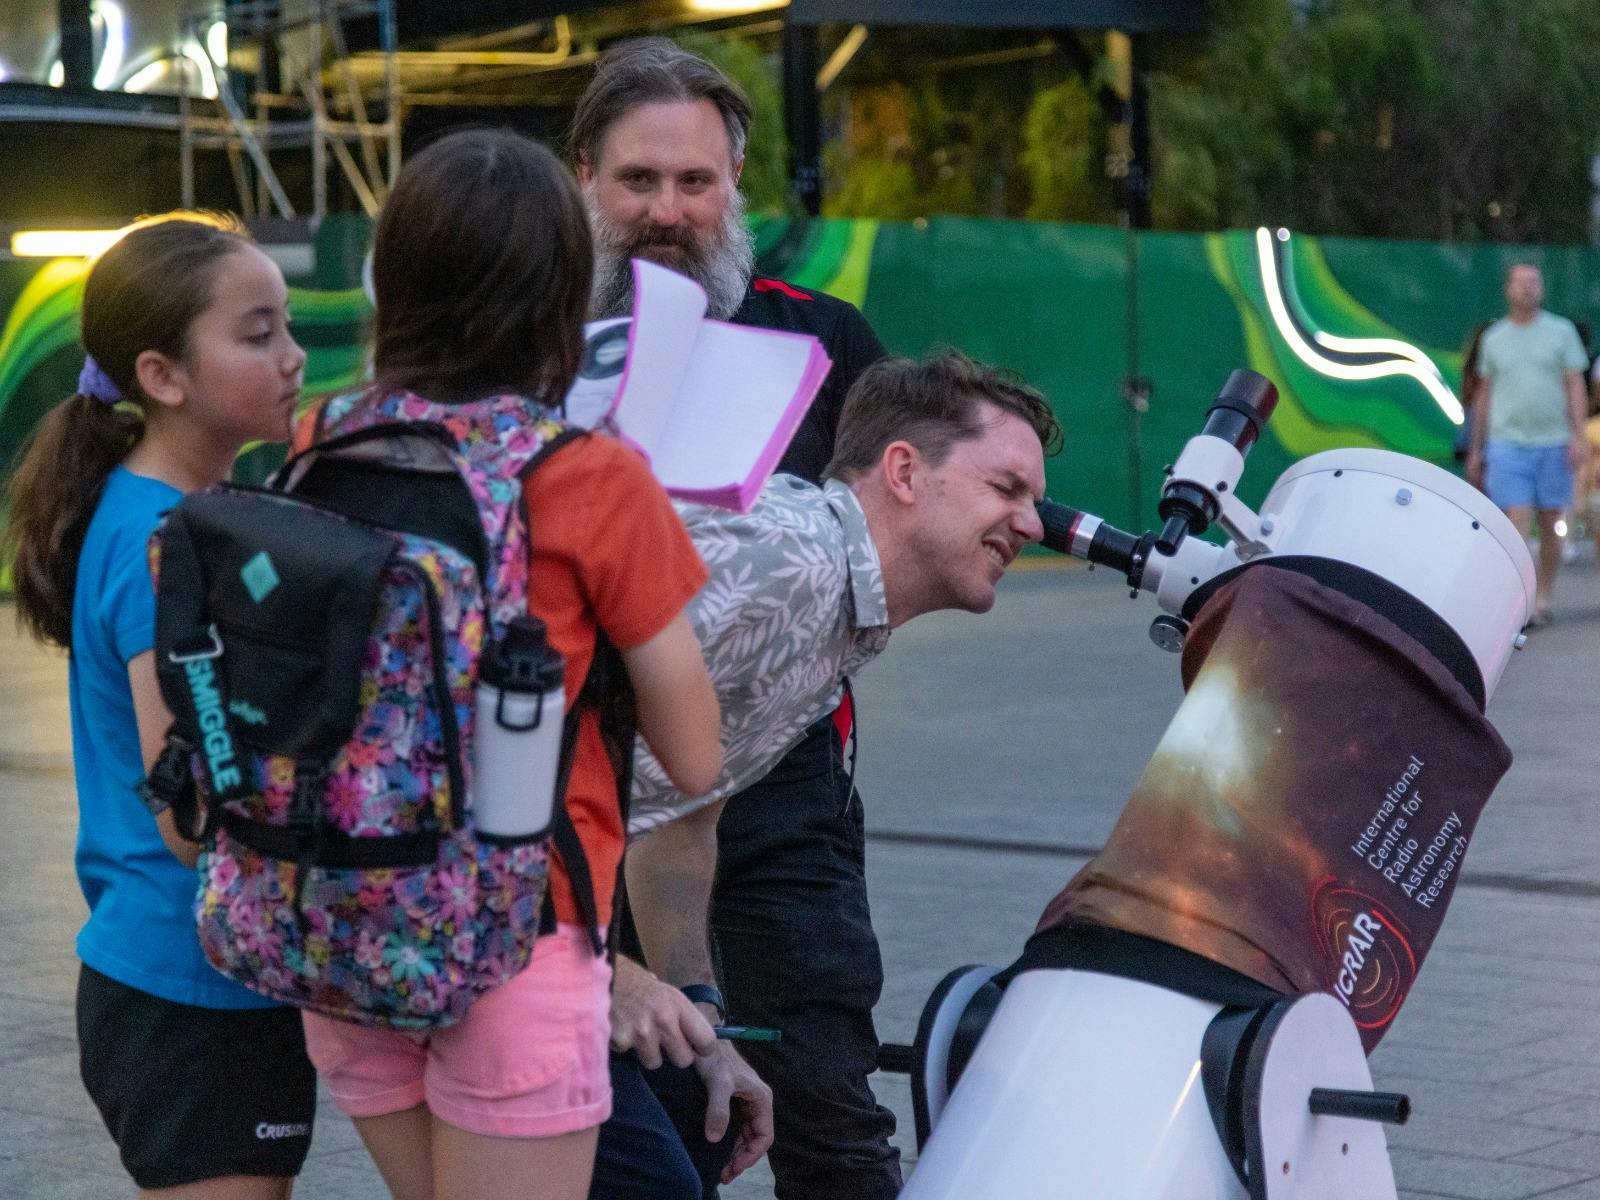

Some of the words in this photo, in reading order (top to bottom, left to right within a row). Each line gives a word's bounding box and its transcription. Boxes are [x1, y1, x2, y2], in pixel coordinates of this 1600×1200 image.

[184, 658, 241, 793] SMIGGLE
[1352, 755, 1424, 857] International
[1367, 818, 1407, 870] Centre
[1402, 790, 1423, 817] for
[1384, 838, 1418, 884] Radio
[1401, 811, 1462, 898] Astronomy
[1416, 835, 1468, 909] Research
[1333, 913, 1382, 1006] ICRAR
